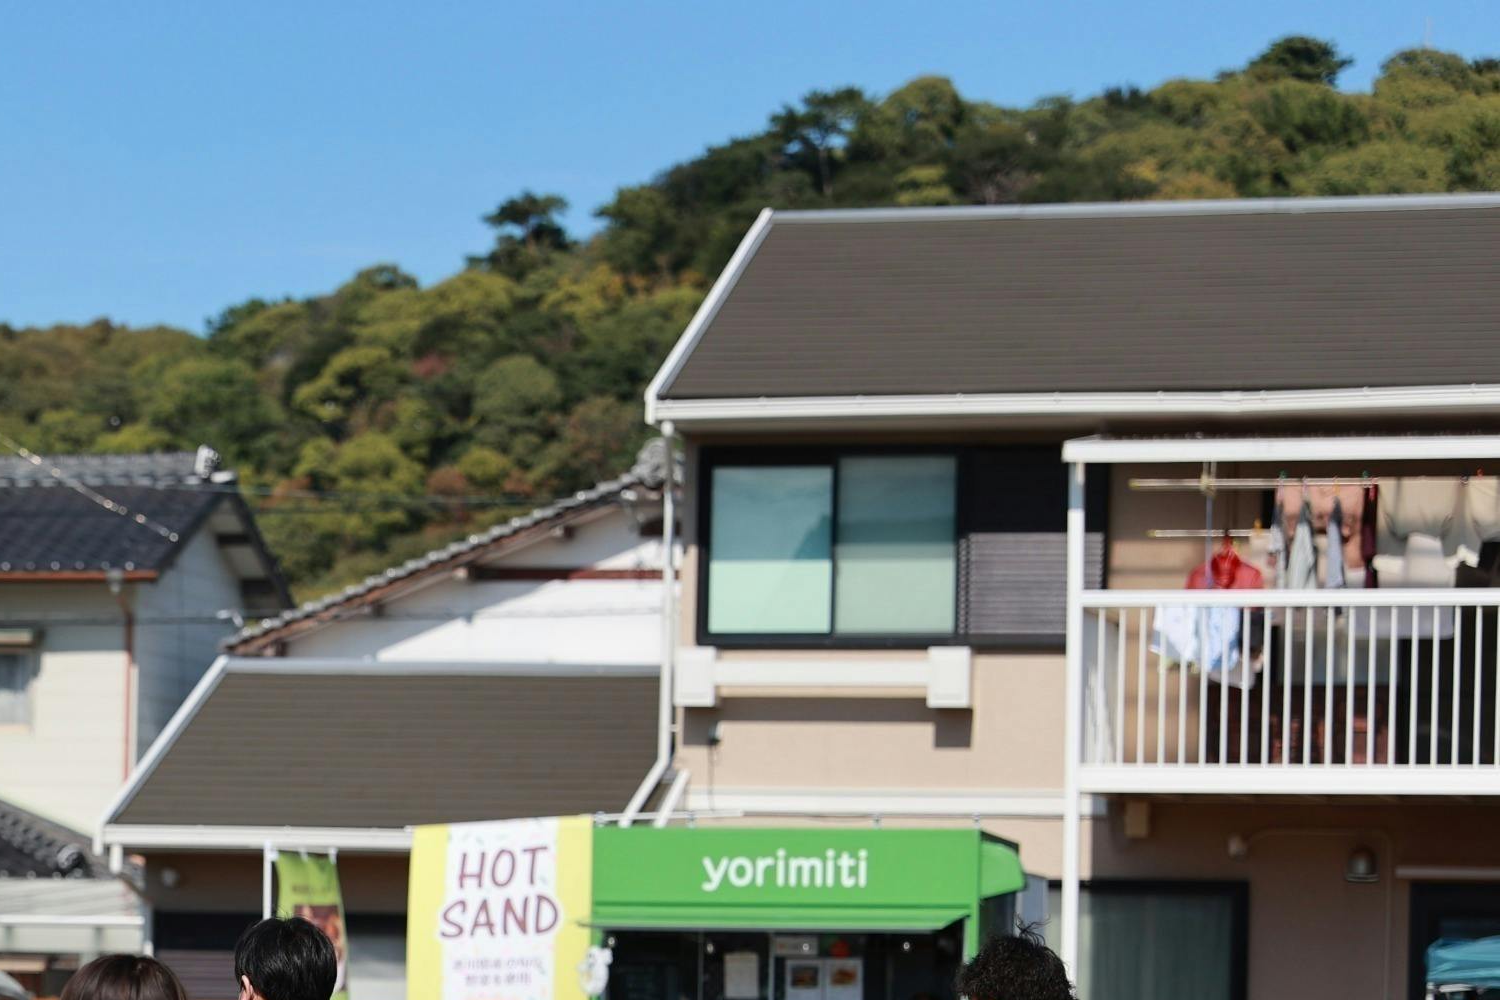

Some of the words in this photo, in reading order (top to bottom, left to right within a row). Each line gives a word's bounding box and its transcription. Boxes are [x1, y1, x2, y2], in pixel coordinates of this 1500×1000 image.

[459, 846, 548, 889] HOT
[701, 848, 869, 892] yorimiti
[440, 895, 558, 938] SAND
